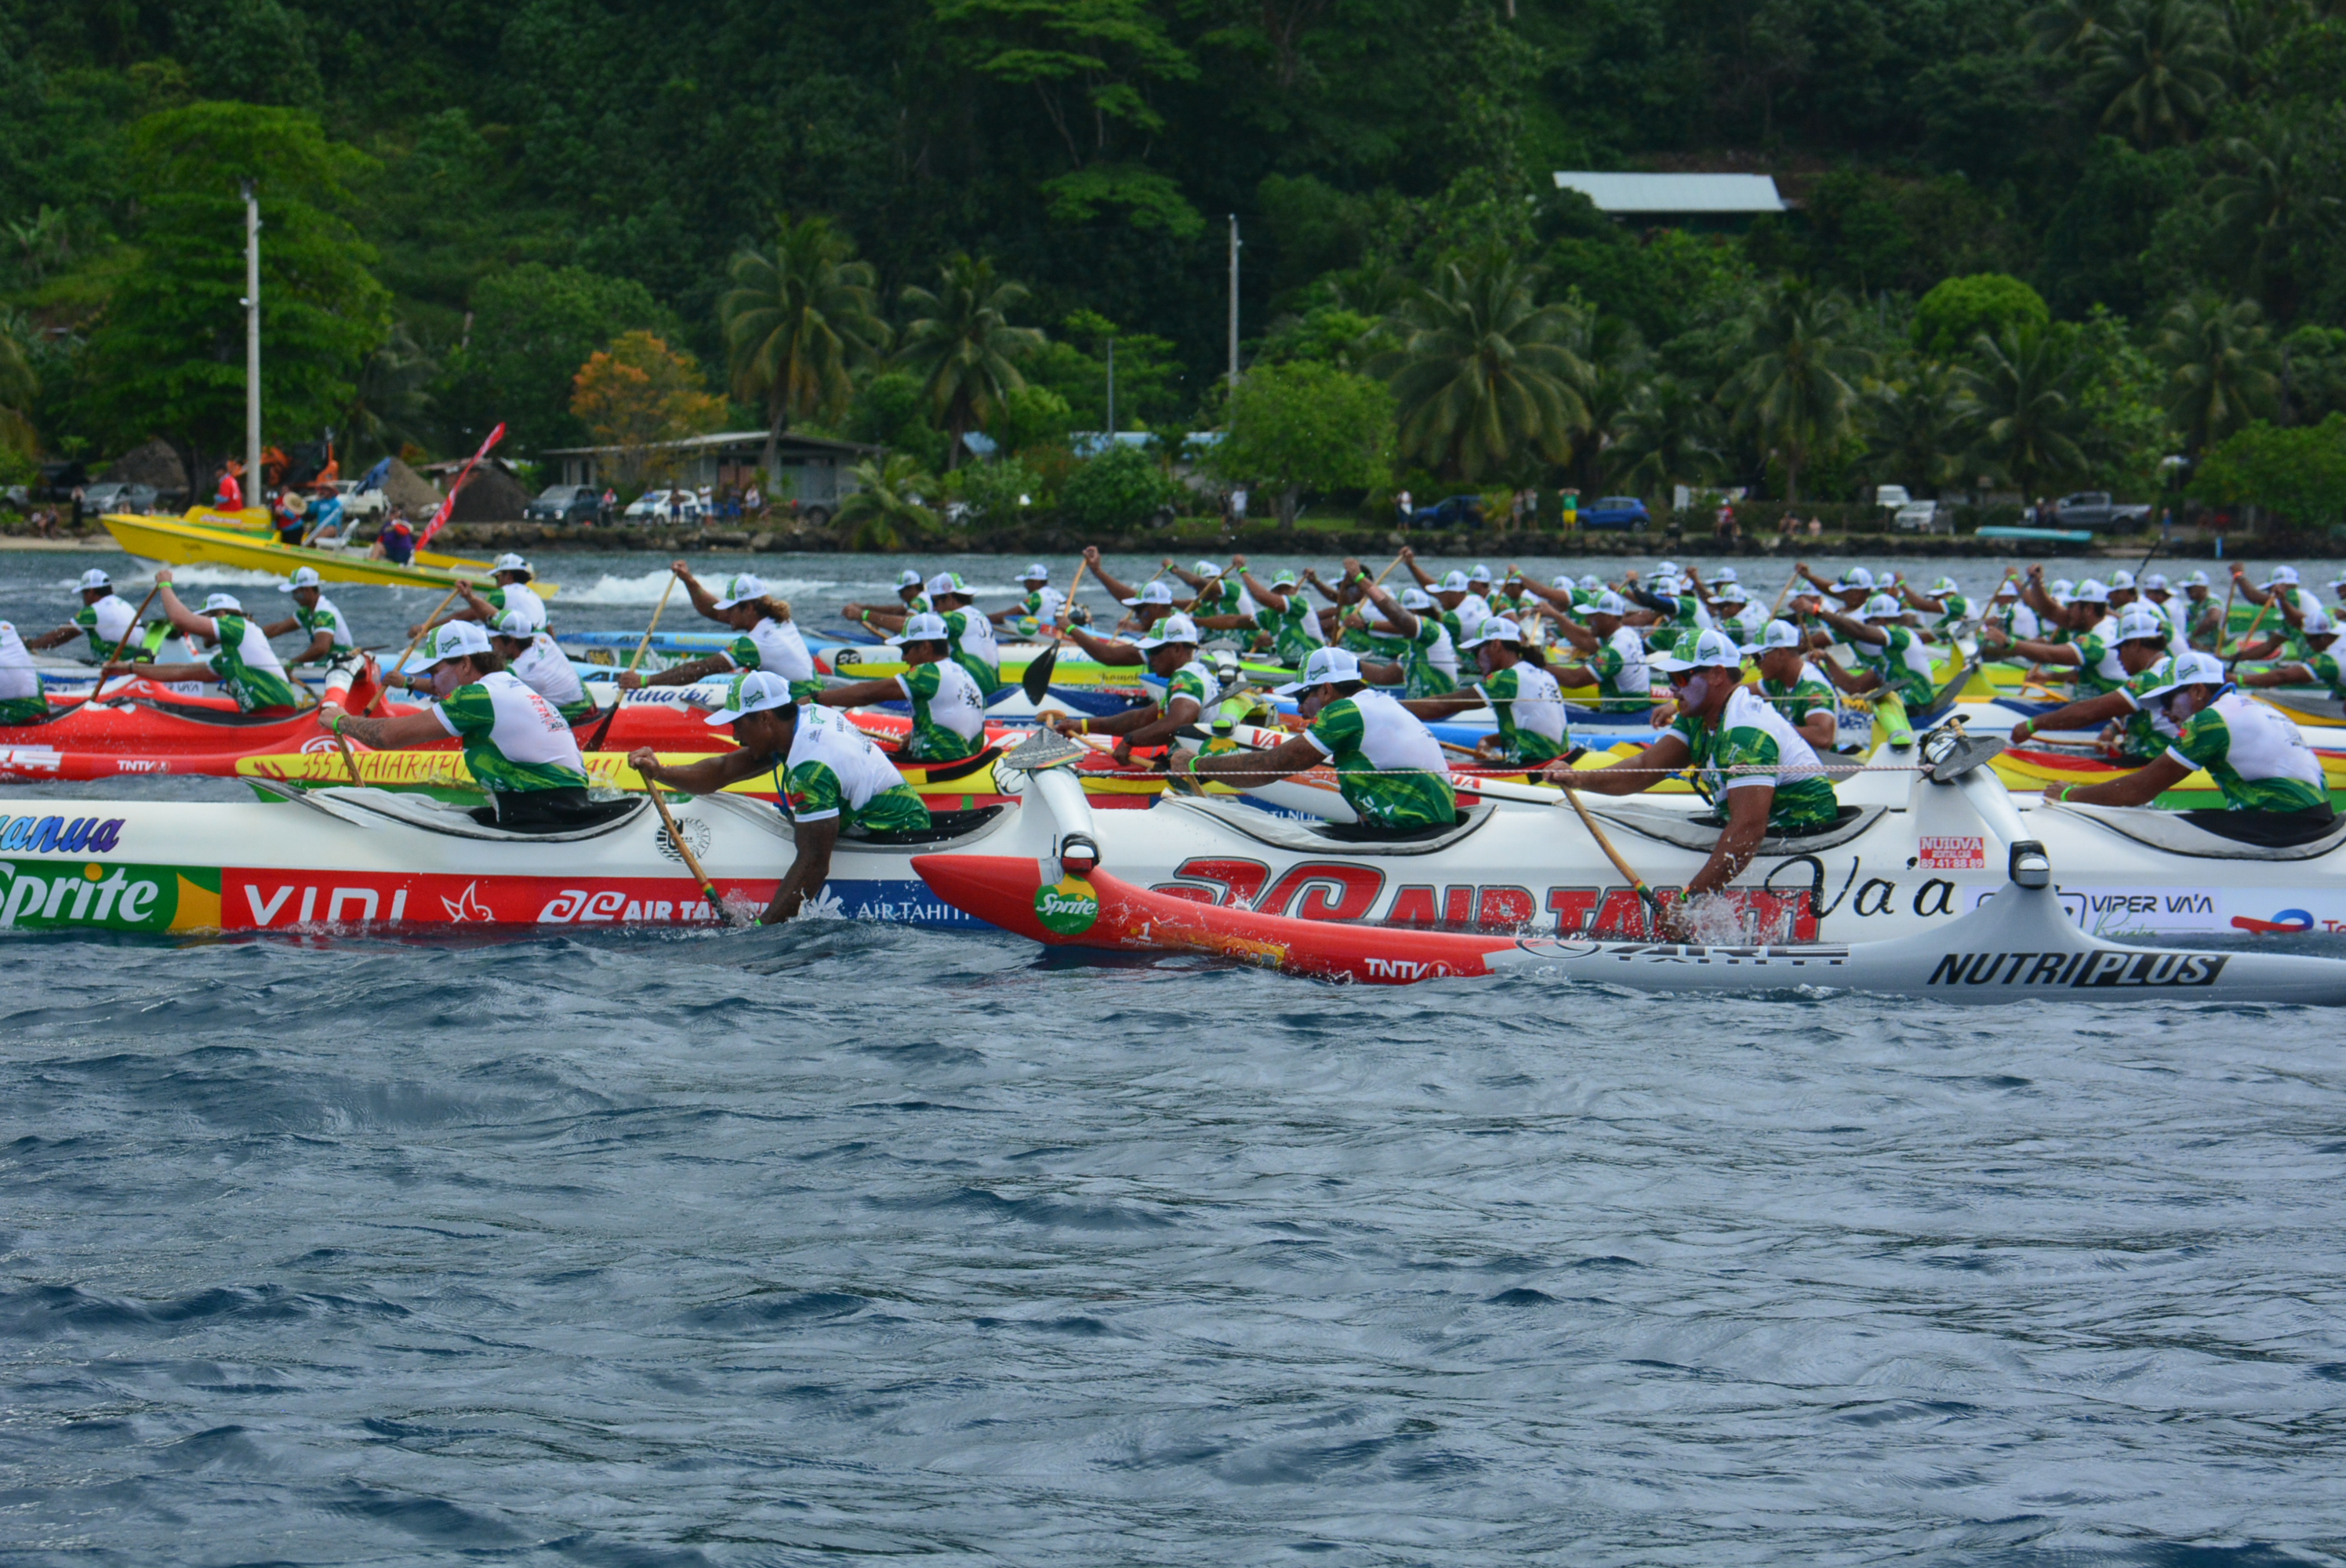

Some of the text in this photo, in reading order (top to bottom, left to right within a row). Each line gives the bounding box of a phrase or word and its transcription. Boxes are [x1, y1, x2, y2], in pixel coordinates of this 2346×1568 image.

[117, 760, 155, 771] TNTV
[0, 815, 125, 854] anua
[1937, 858, 1950, 868] 41
[0, 861, 159, 928] prite
[1763, 855, 1956, 918] Va'a
[243, 884, 408, 926] VINI
[622, 900, 674, 920] AIR
[856, 902, 898, 921] AIR
[1036, 893, 1098, 916] Sprite
[1383, 884, 1825, 944] AIR TATI
[2091, 894, 2215, 913] VIPER VA'A
[1364, 957, 1429, 980] TNTV
